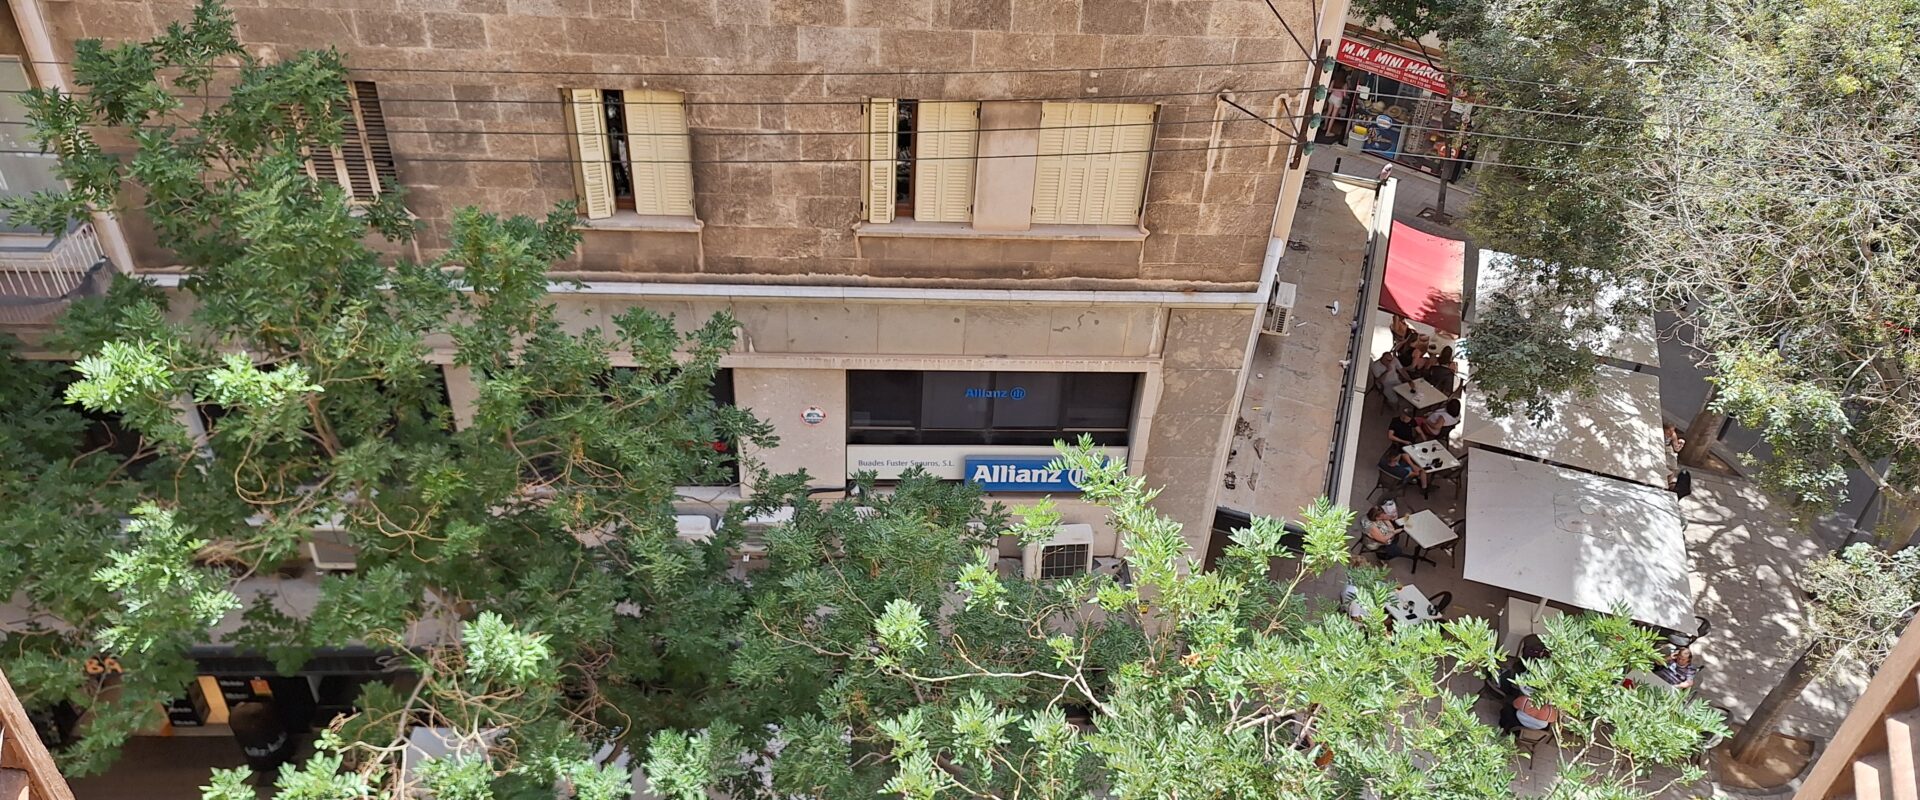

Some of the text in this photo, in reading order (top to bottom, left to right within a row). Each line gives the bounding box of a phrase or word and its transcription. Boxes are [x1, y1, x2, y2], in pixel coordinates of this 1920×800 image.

[1342, 42, 1445, 82] M.M. MINI MARKE
[965, 388, 1008, 398] Allianz
[972, 464, 1062, 483] Allianz
